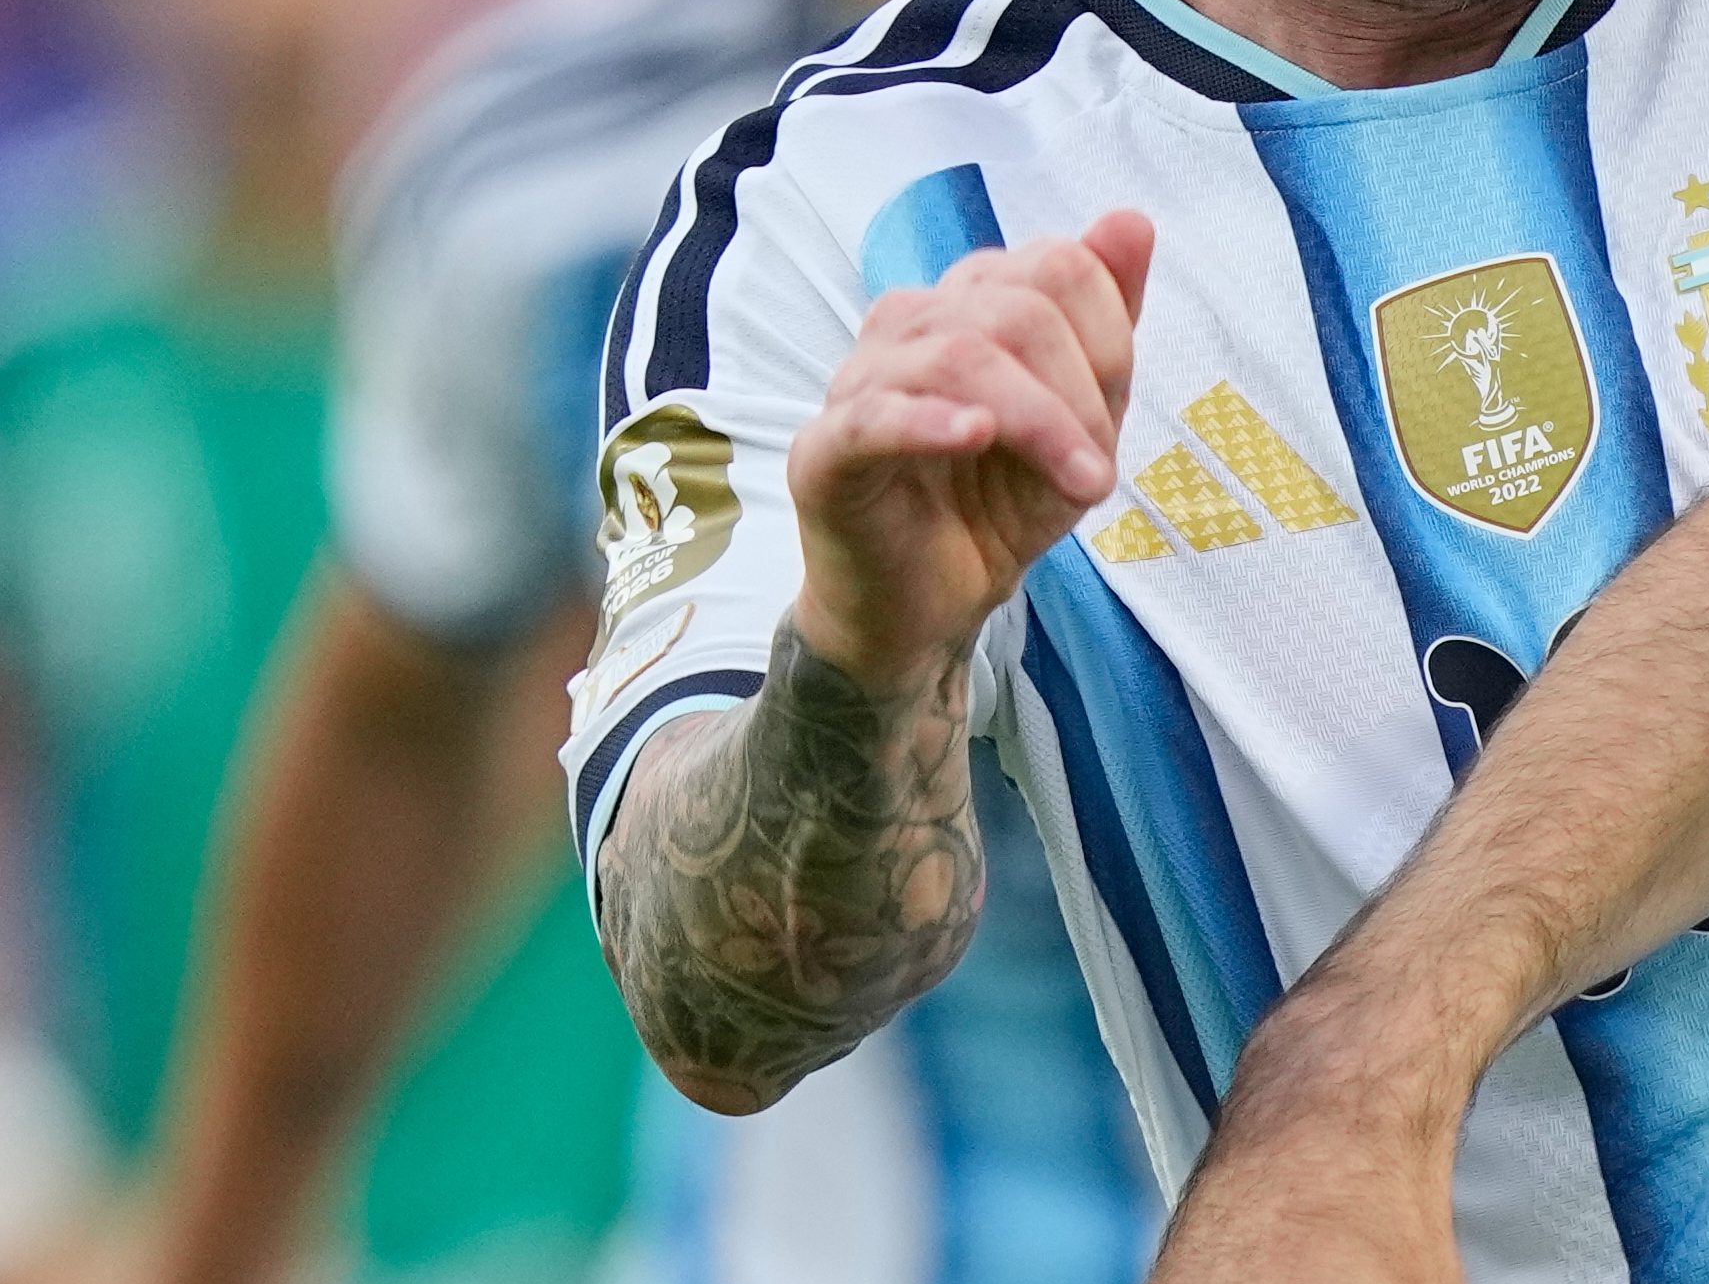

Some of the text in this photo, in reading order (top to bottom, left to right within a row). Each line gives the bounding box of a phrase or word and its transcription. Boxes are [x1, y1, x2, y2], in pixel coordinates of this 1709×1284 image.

[1446, 446, 1577, 498] WORLD CHAMPIONS
[1488, 474, 1542, 506] 2022
[644, 544, 679, 569] CUP
